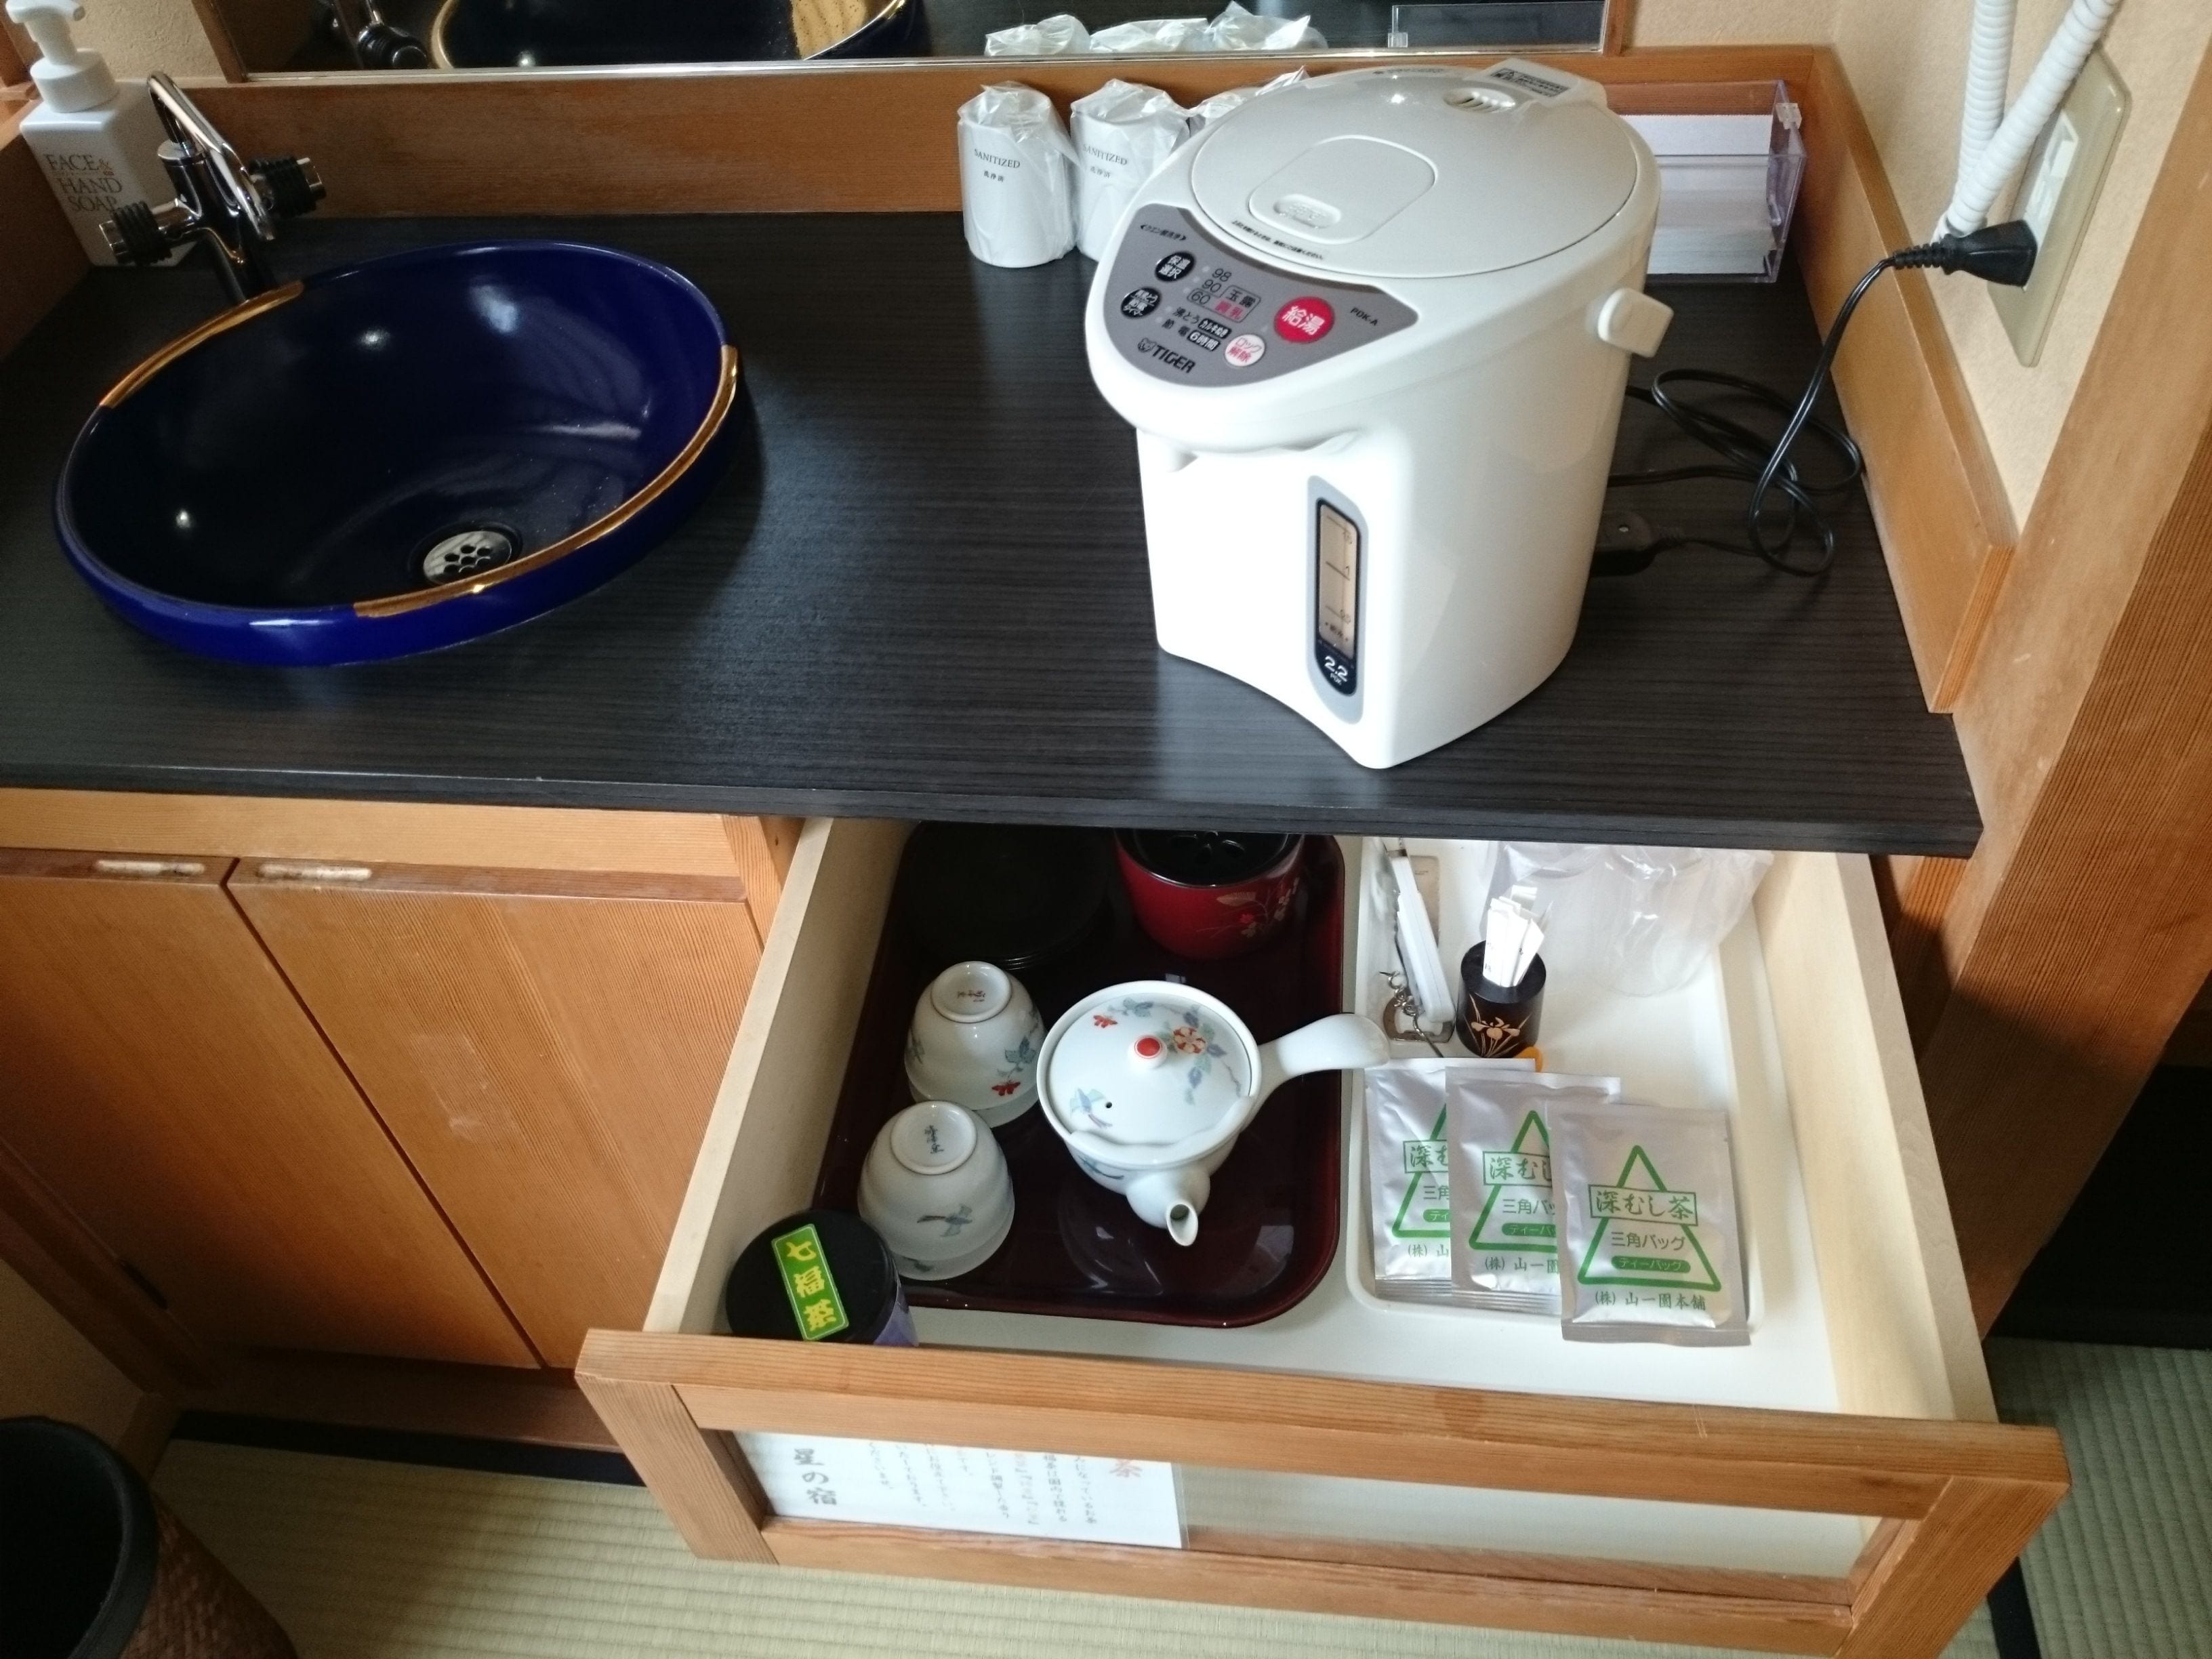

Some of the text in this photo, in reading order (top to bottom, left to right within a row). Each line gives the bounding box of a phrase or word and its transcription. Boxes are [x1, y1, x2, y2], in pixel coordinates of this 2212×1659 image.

[43, 154, 100, 171] FACE
[974, 148, 1021, 169] SANITIZED
[1084, 143, 1128, 165] SANITIZED
[55, 178, 122, 194] HAND
[68, 196, 117, 211] SOAP
[1212, 268, 1232, 282] 98
[1202, 279, 1222, 293] 90
[1191, 291, 1210, 304] 60
[1282, 305, 1326, 336] 給湯
[1350, 307, 1379, 326] PDK-A
[1189, 331, 1219, 350] 6時間
[1152, 344, 1196, 373] TIGER
[1324, 655, 1348, 682] 2.2
[1596, 1190, 1694, 1221] 深むし茶
[1612, 1231, 1686, 1251] 三角バッグ
[1485, 1256, 1505, 1271] (株)
[1619, 1257, 1683, 1272] ティーバッグ
[1595, 1290, 1616, 1306] (株)
[794, 1448, 838, 1505] 星の宿
